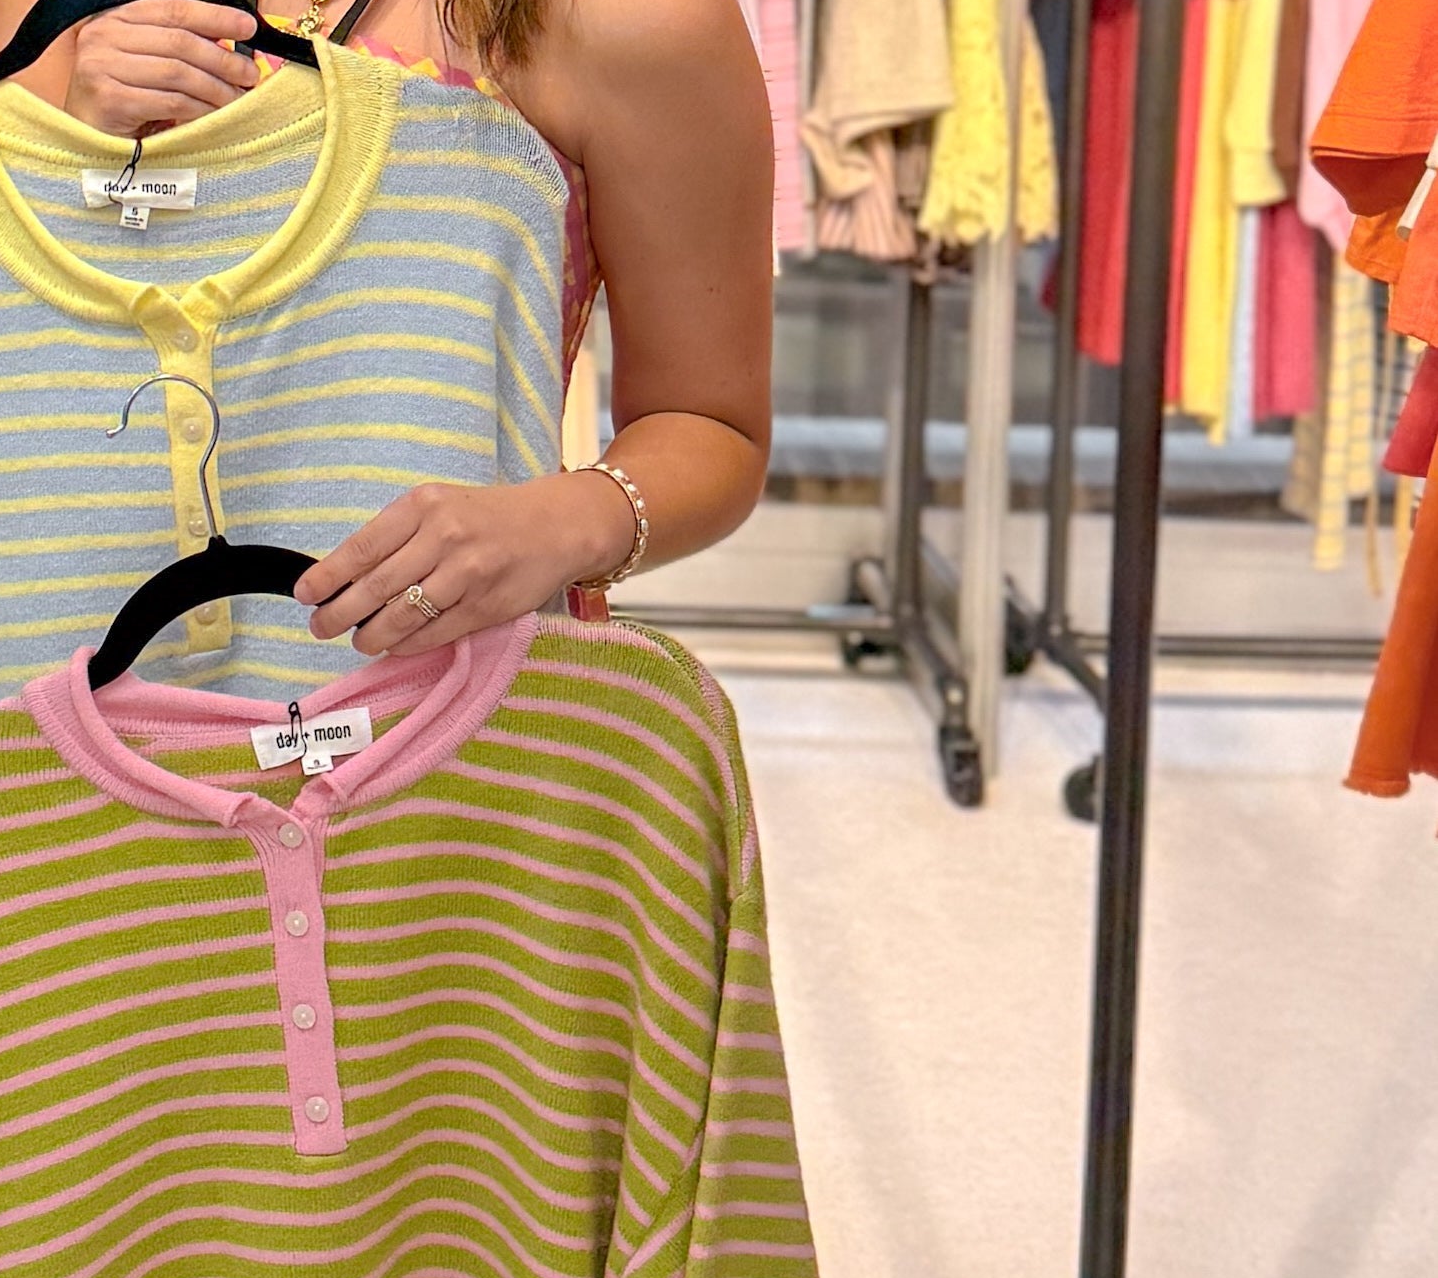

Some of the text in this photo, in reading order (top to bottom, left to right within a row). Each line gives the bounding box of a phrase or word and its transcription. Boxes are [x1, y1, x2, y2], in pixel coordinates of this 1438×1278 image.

[142, 183, 177, 195] moon
[276, 732, 298, 749] day
[314, 725, 351, 742] moon
